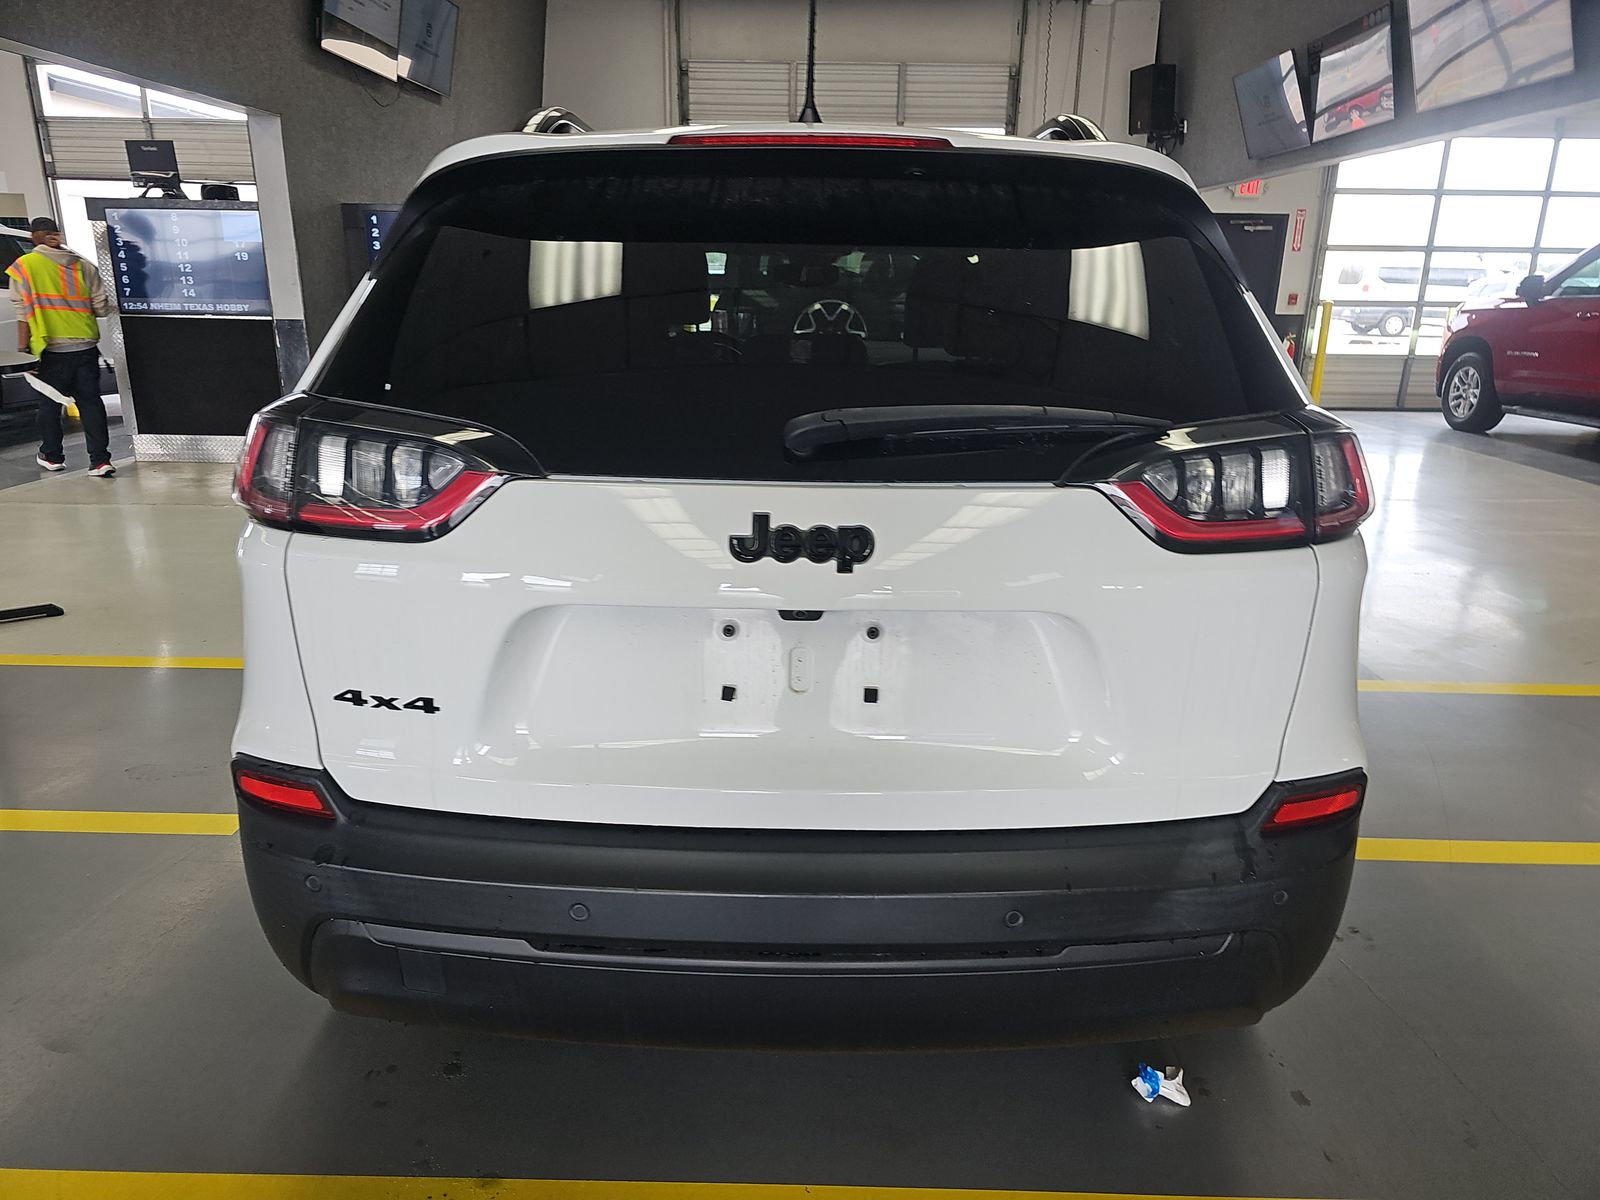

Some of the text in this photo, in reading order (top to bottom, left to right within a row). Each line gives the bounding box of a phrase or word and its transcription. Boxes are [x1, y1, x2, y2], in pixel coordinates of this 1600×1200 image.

[1239, 179, 1261, 196] EXIT
[112, 212, 119, 221] 1
[170, 213, 178, 221] 8
[370, 215, 377, 224] 1
[114, 225, 122, 234] 2
[172, 226, 180, 234] 9
[371, 228, 380, 237] 2
[116, 238, 124, 247] 3
[175, 239, 188, 247] 10
[373, 241, 381, 250] 3
[118, 250, 126, 259] 4
[177, 251, 189, 260] 11
[234, 252, 249, 261] 19
[120, 263, 128, 271] 5
[178, 264, 192, 272] 12
[122, 275, 130, 284] 6
[180, 276, 194, 285] 13
[124, 288, 131, 296] 7
[181, 289, 196, 297] 14
[183, 303, 214, 311] TEXAS
[216, 303, 250, 312] HOBBY
[729, 512, 875, 573] Jeep
[333, 689, 441, 714] 4x4
